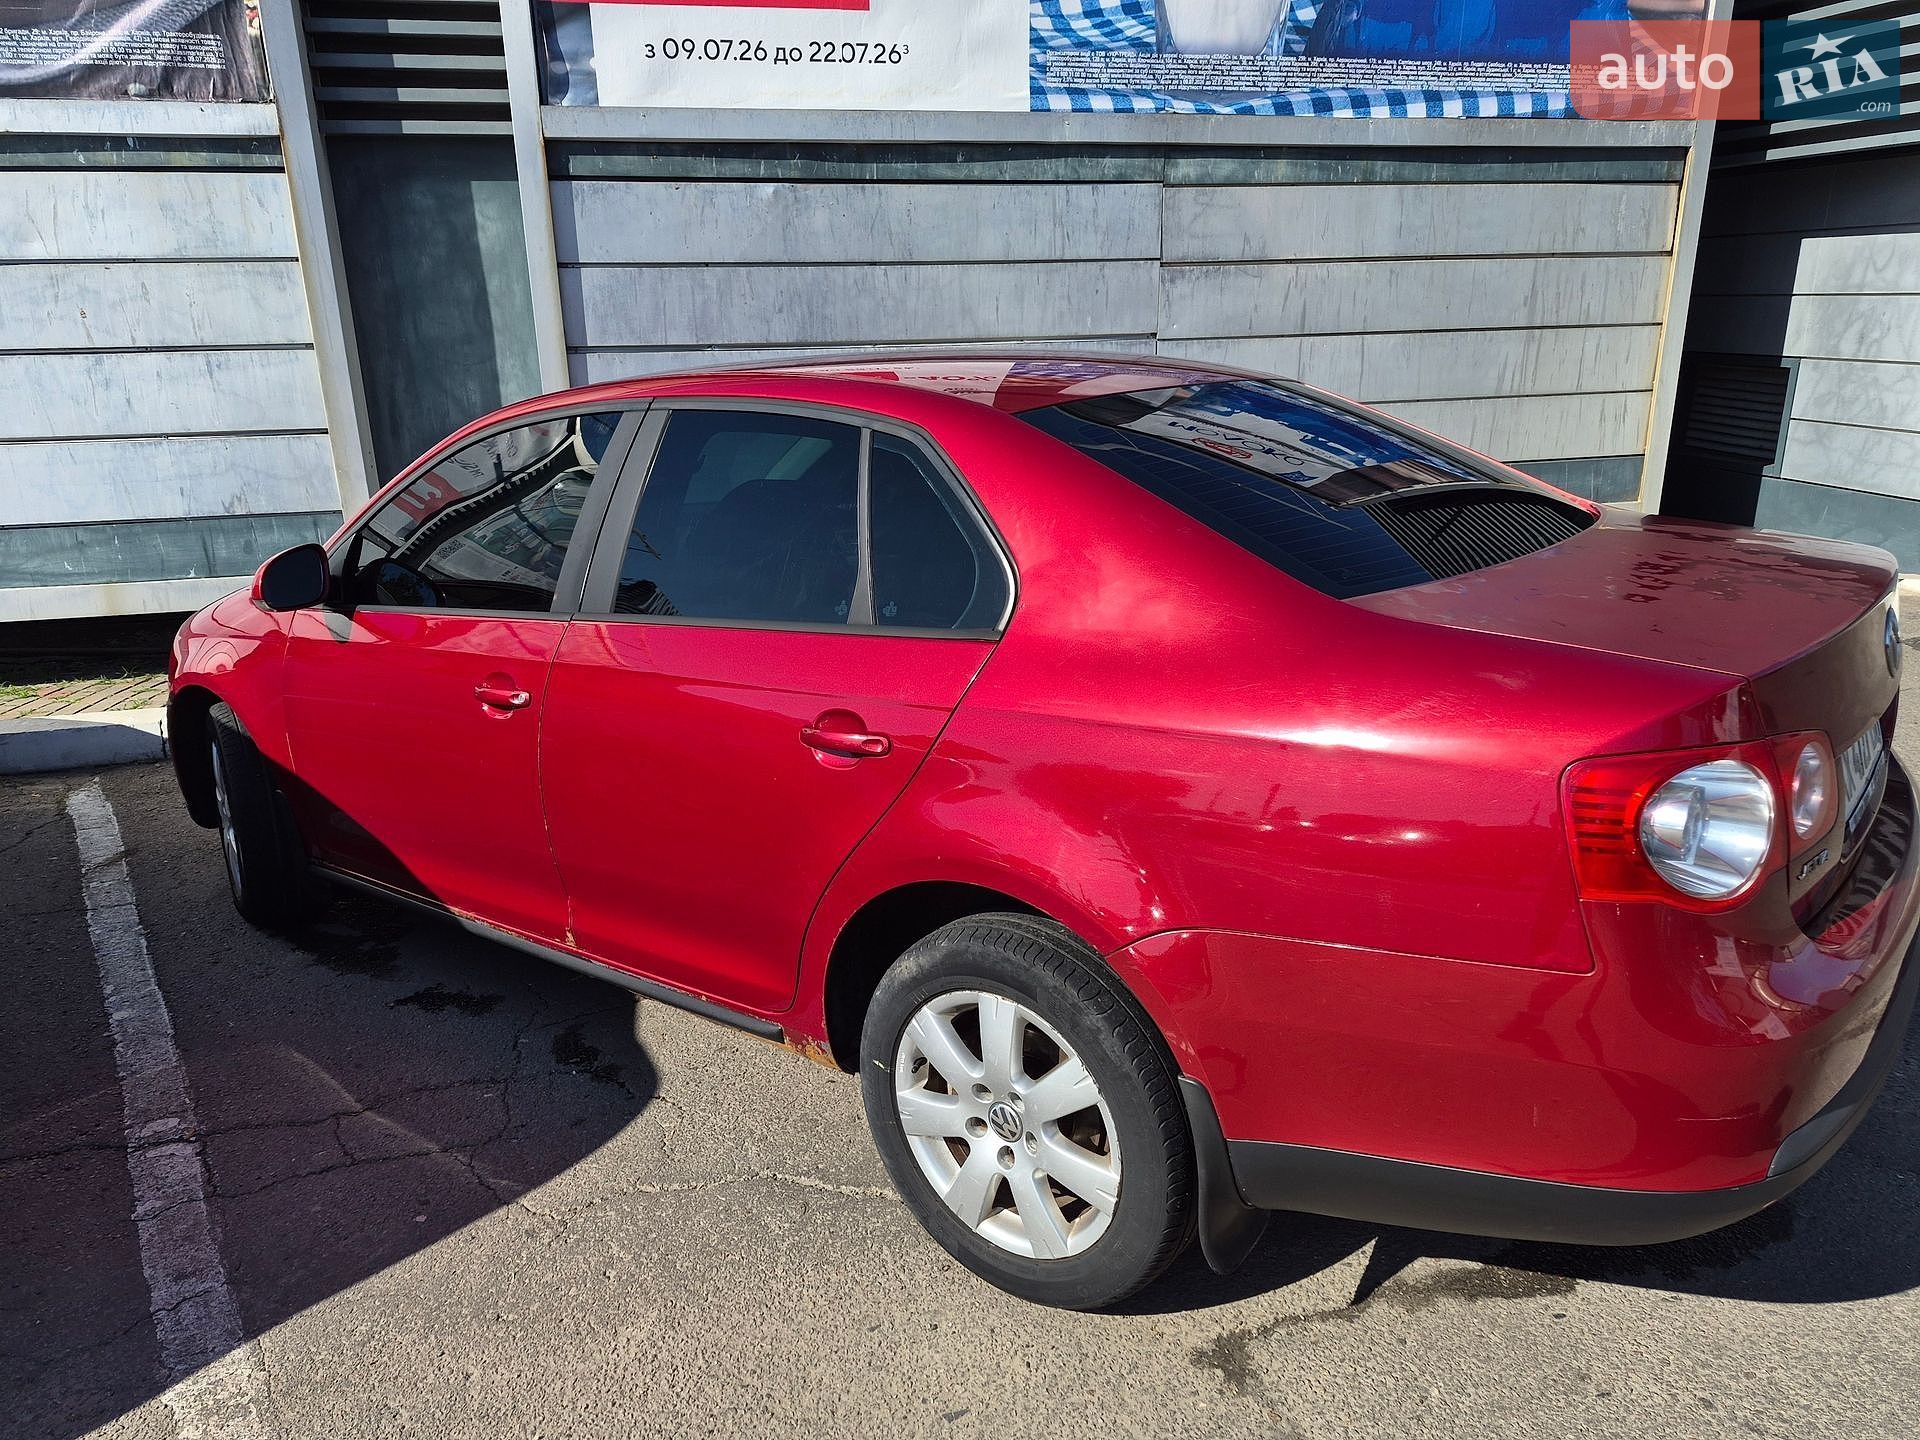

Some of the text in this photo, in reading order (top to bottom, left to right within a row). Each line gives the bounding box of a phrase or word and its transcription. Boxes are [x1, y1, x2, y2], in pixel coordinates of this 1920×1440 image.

[644, 43, 656, 59] з
[662, 37, 768, 62] 09.07.26
[773, 46, 802, 64] до
